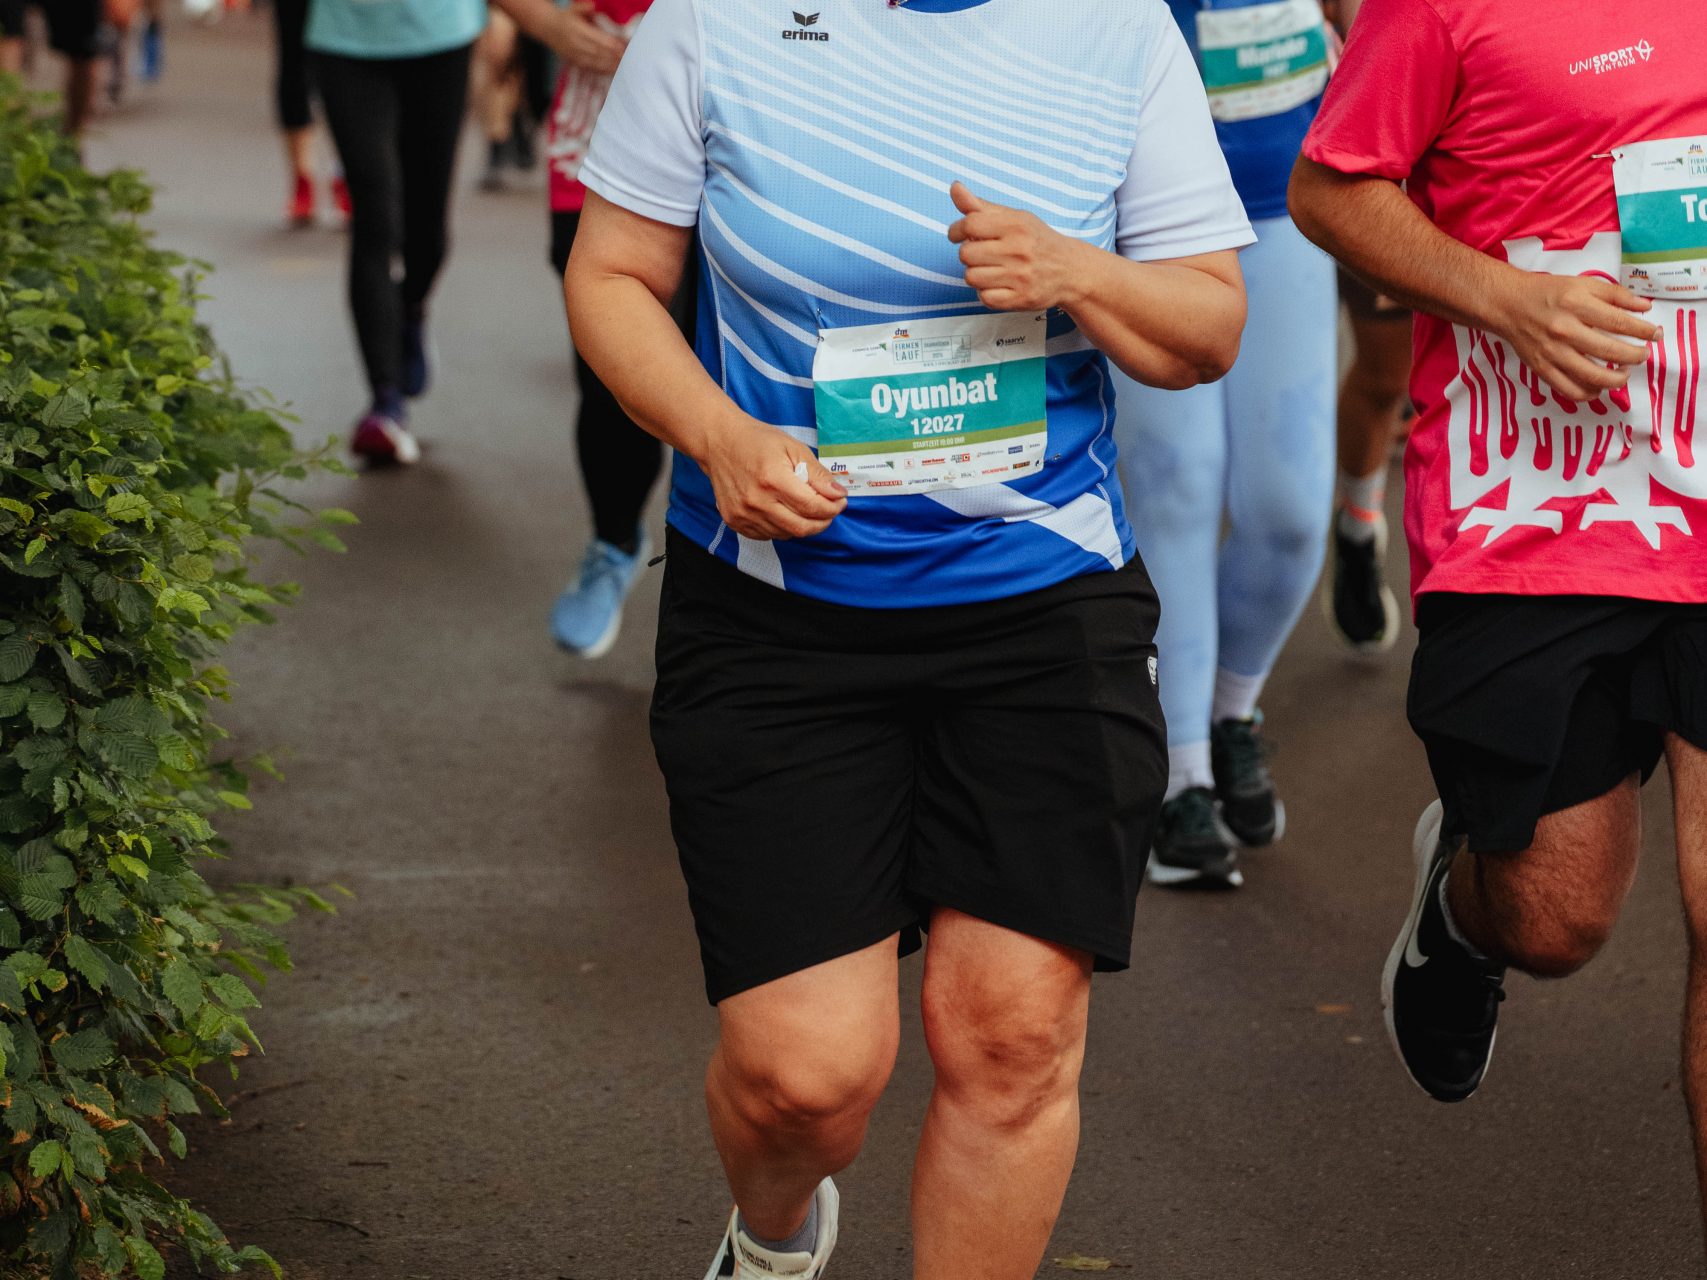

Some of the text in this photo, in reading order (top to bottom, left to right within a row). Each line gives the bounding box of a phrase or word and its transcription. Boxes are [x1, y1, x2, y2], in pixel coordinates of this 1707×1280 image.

[782, 29, 829, 41] erima
[895, 342, 919, 351] FIRMEN
[896, 350, 919, 361] LAUF
[871, 372, 998, 418] Oyunbat
[911, 413, 964, 435] 12027
[831, 462, 847, 472] dm
